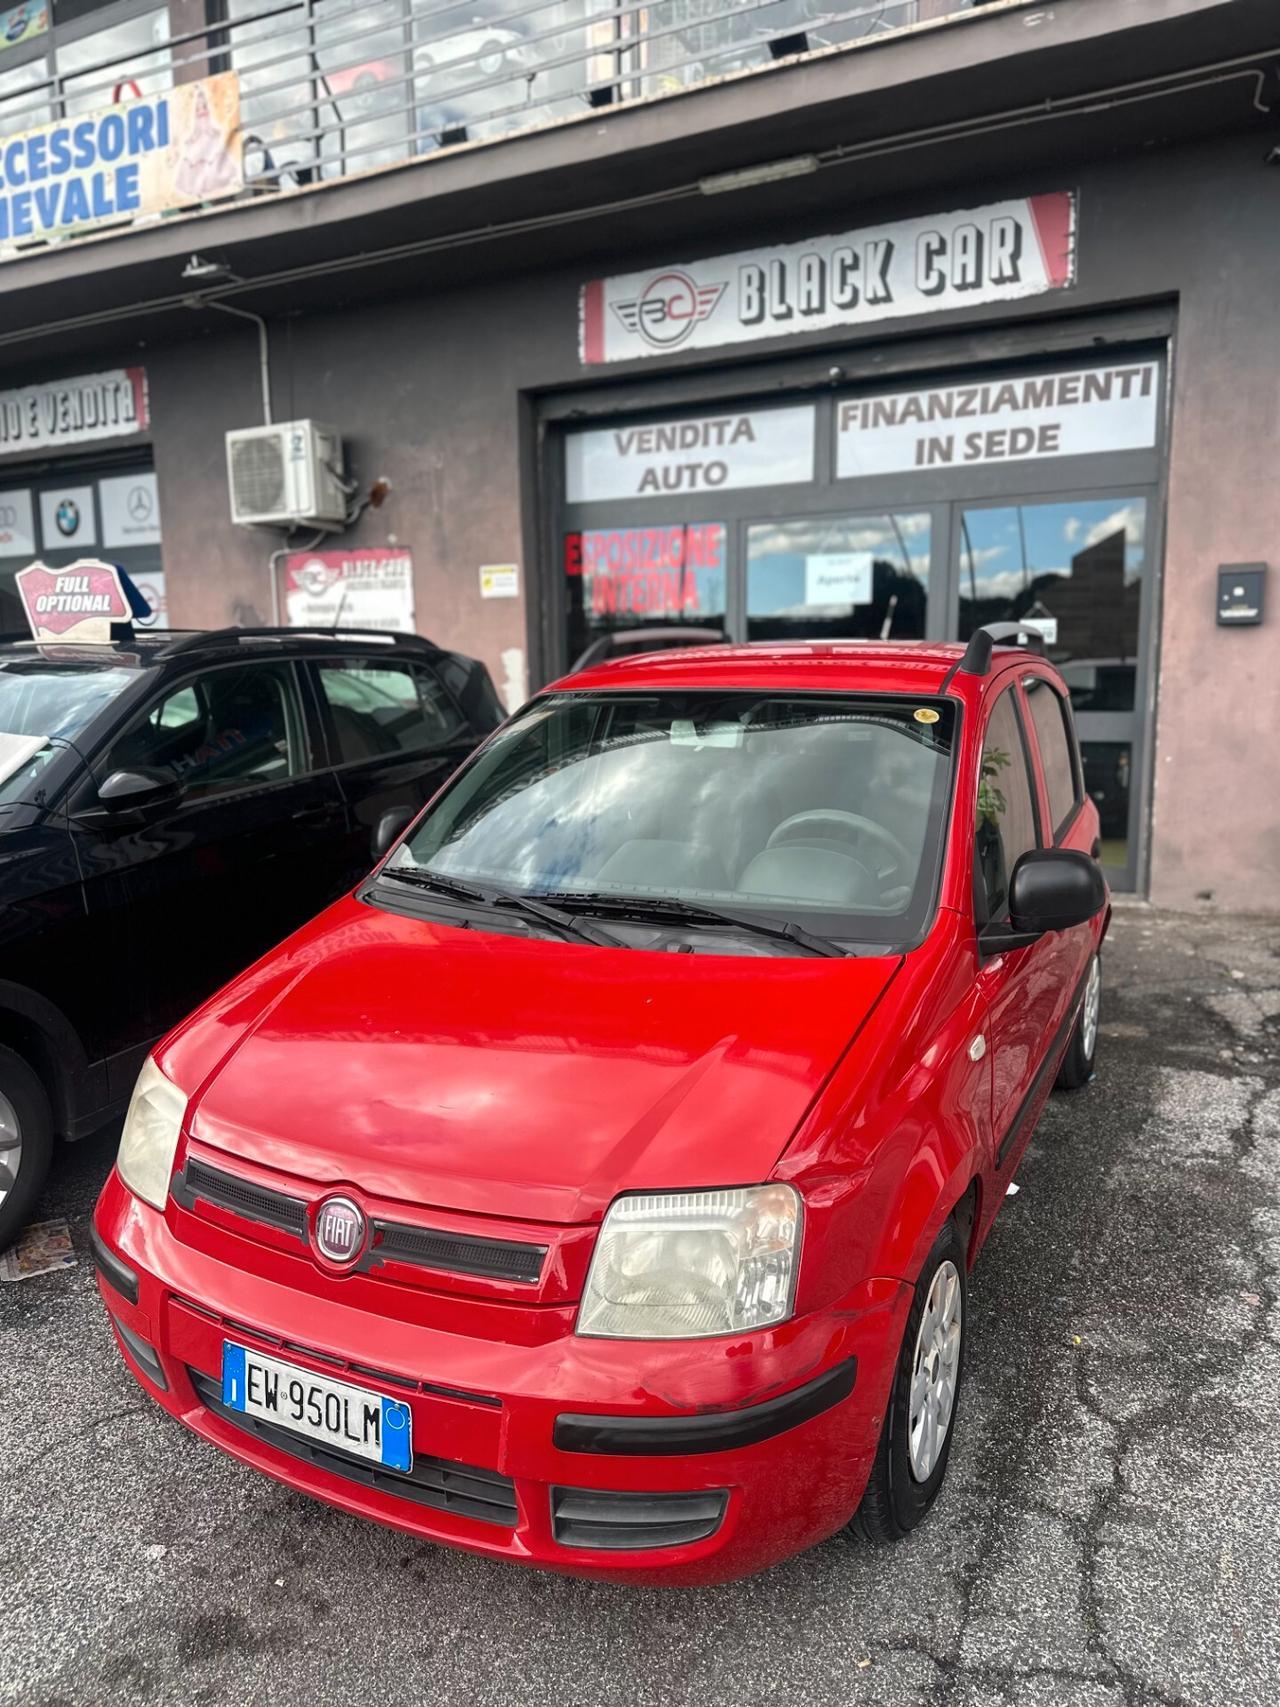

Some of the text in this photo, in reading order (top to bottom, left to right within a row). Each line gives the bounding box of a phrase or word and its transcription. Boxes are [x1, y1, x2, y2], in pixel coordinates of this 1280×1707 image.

[0, 100, 169, 189] CESSORI
[738, 216, 1022, 326] BLACK CAR
[45, 378, 136, 434] VENDITA
[841, 367, 1153, 432] FINANZIAMENTI
[614, 417, 756, 457] VENDITA
[915, 424, 1061, 466] IN SEDE
[637, 460, 728, 493] AUTO
[565, 523, 721, 576] ESPOSIZIONE
[35, 594, 111, 612] OPTIONAL
[55, 575, 90, 593] FULL
[592, 570, 699, 615] INTERNA
[325, 1215, 353, 1247] FIAT
